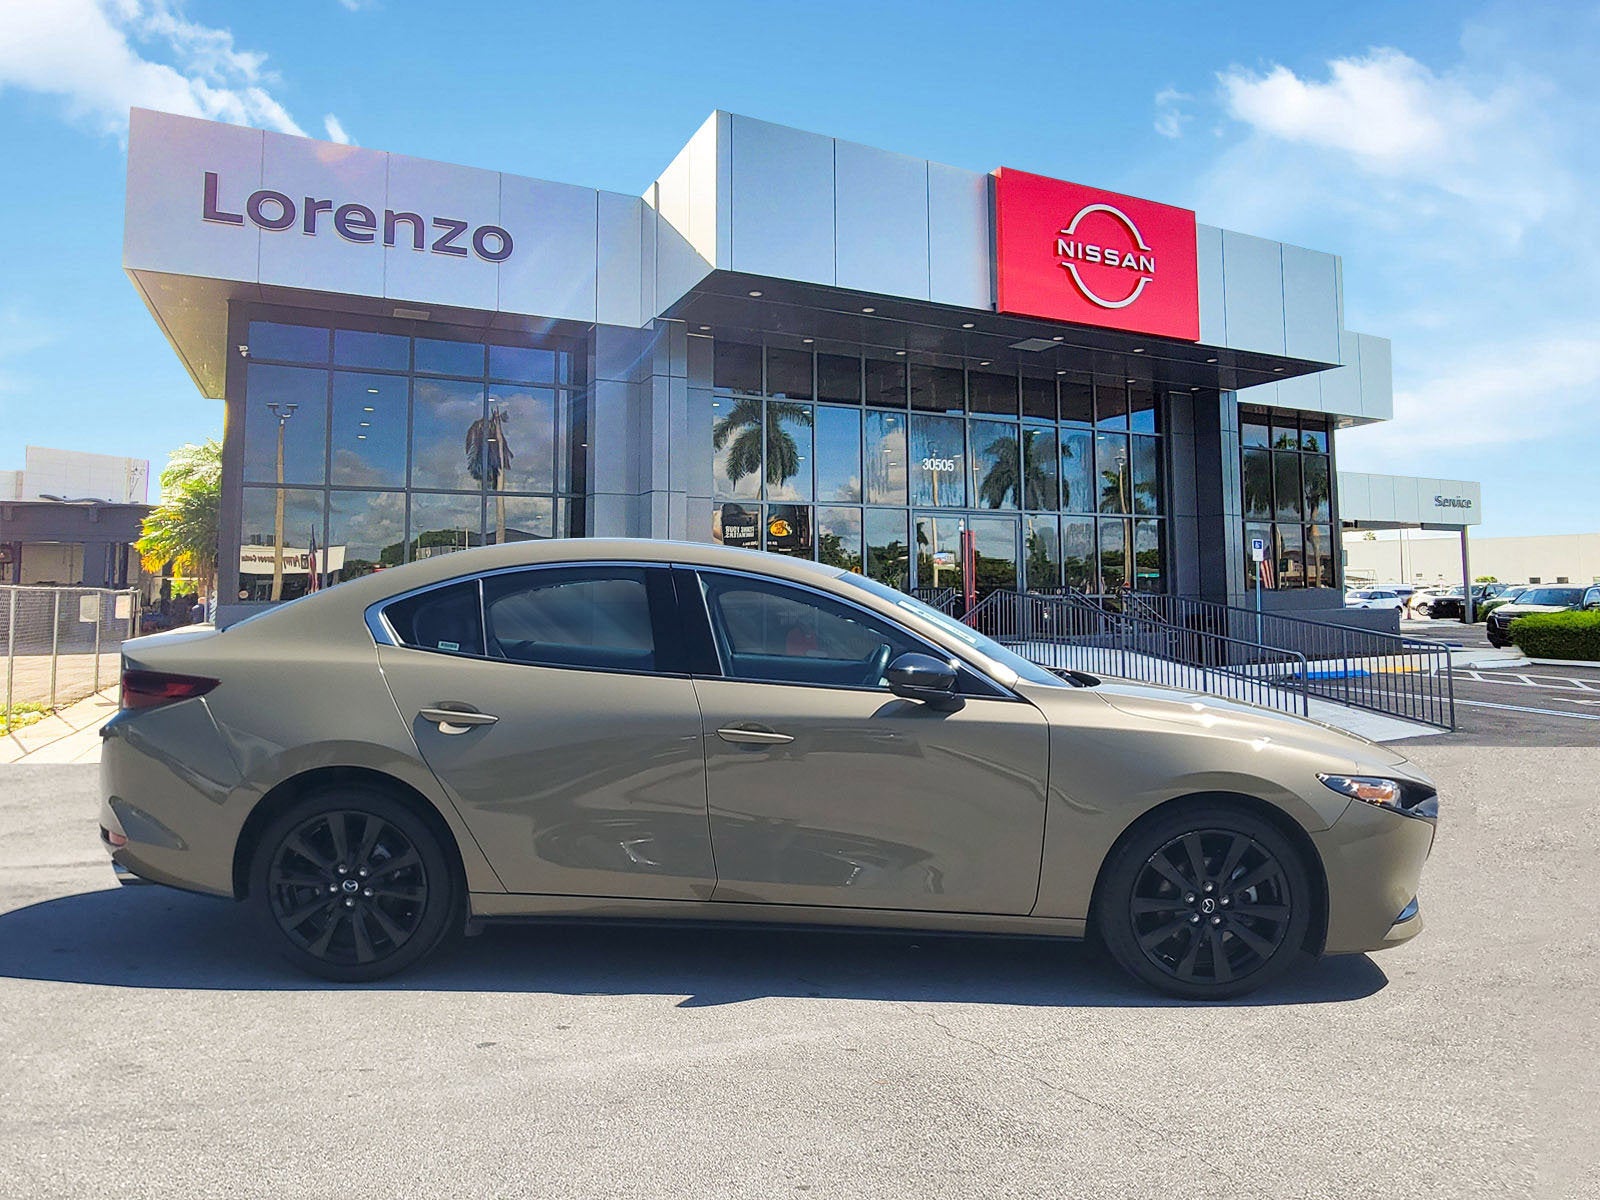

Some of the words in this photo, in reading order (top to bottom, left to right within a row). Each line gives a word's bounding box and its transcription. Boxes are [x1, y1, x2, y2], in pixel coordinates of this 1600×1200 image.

[202, 171, 514, 262] Lorenzo
[1057, 238, 1155, 273] NISSAN
[922, 458, 954, 471] 30505
[1434, 495, 1472, 508] Service
